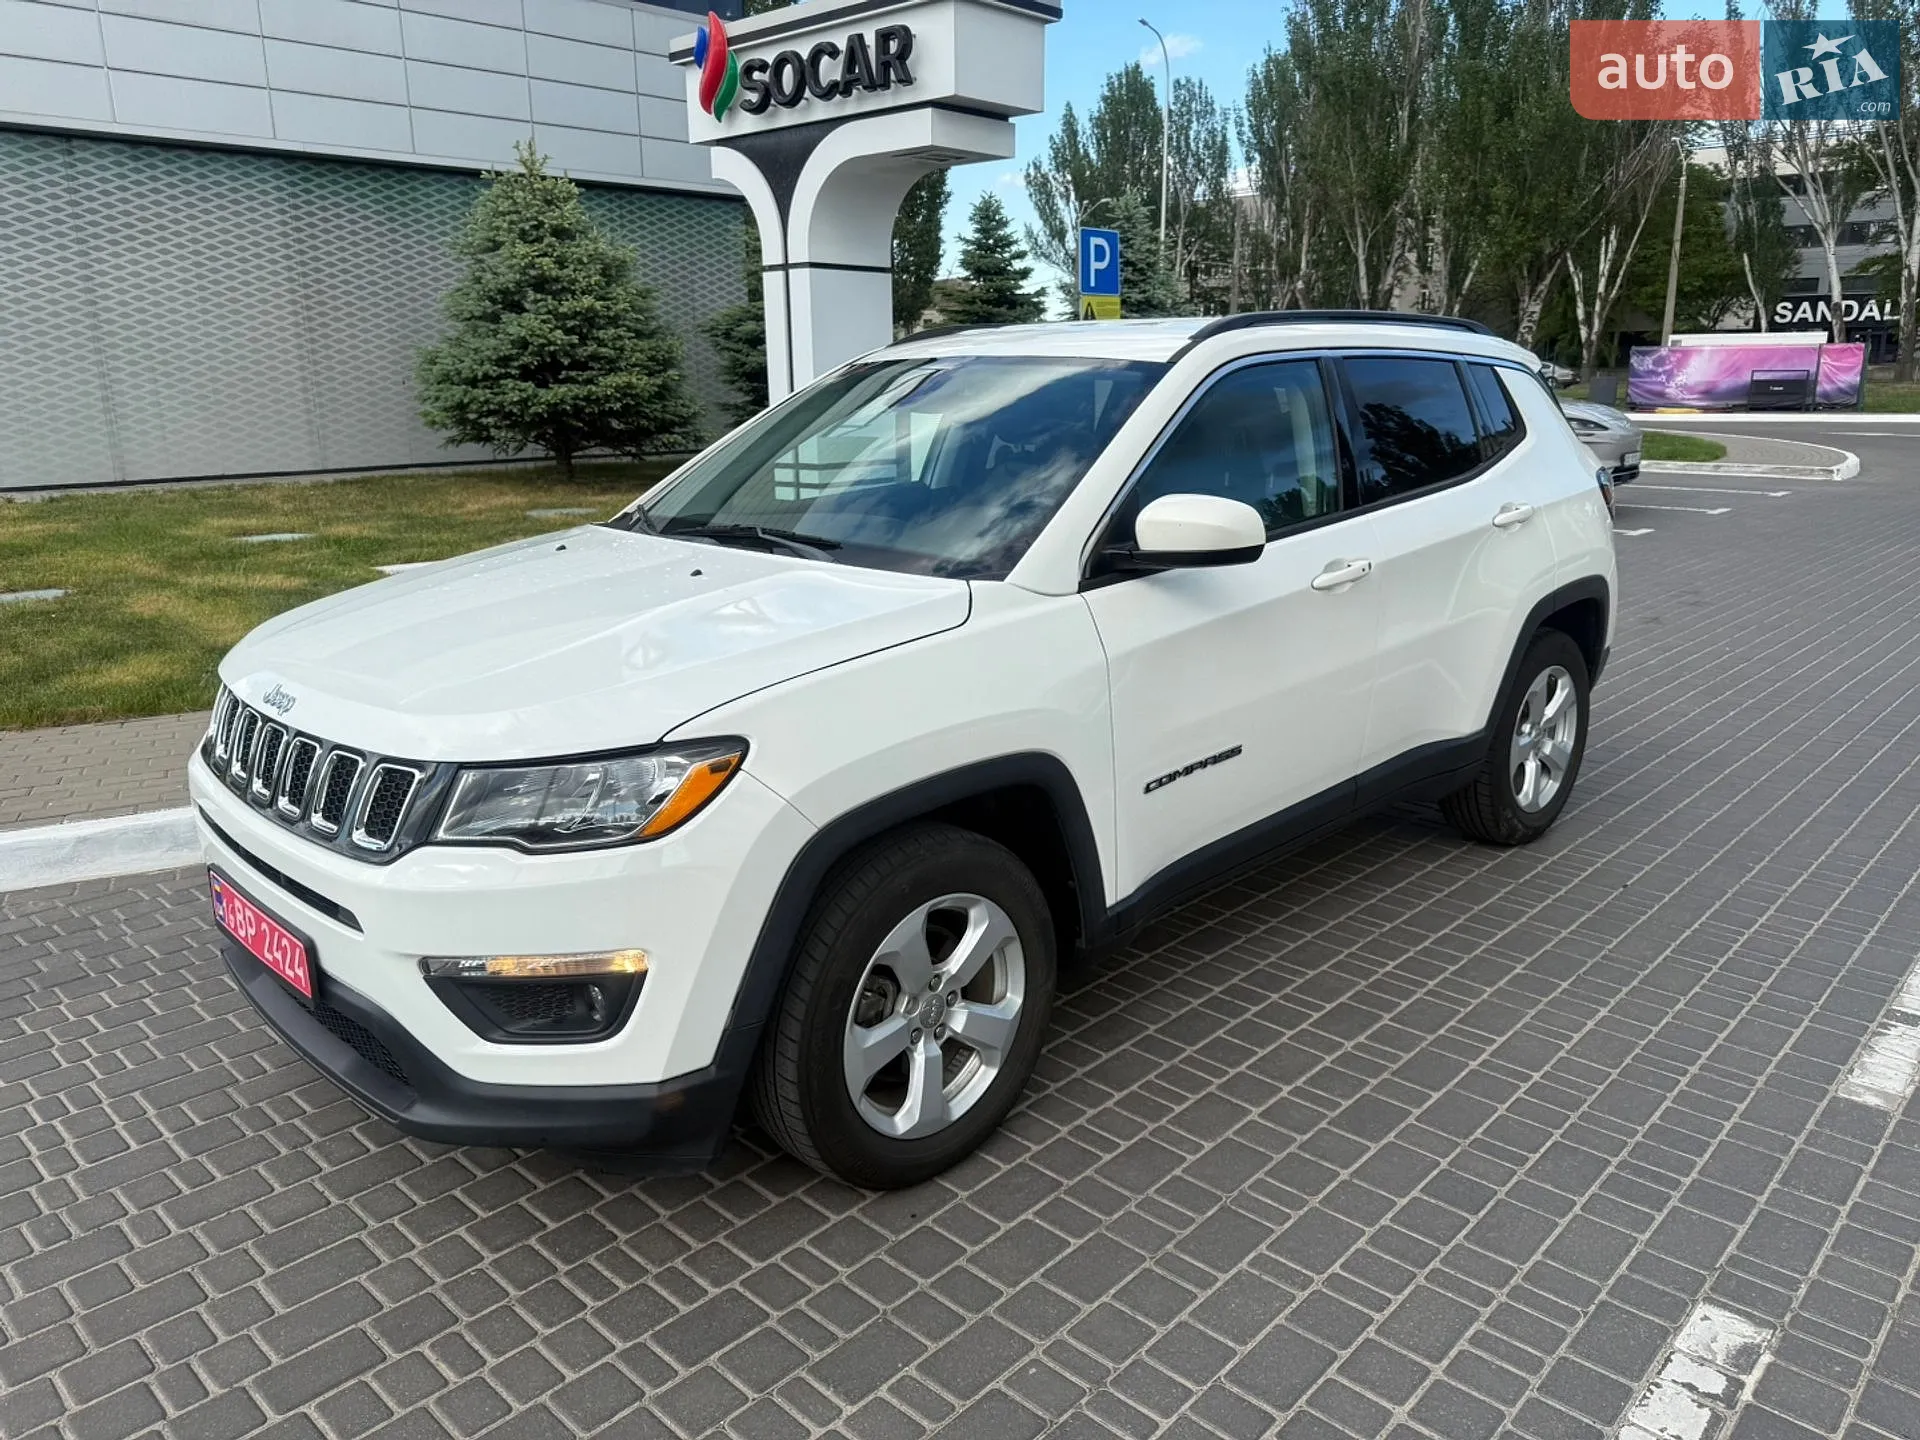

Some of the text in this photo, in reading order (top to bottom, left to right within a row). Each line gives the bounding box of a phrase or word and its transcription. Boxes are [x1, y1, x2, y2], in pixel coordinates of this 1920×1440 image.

[738, 23, 914, 116] SOCAR
[1090, 236, 1110, 287] P
[263, 683, 296, 716] Jeep
[1143, 744, 1243, 794] COMPASS
[261, 921, 306, 988] 2424
